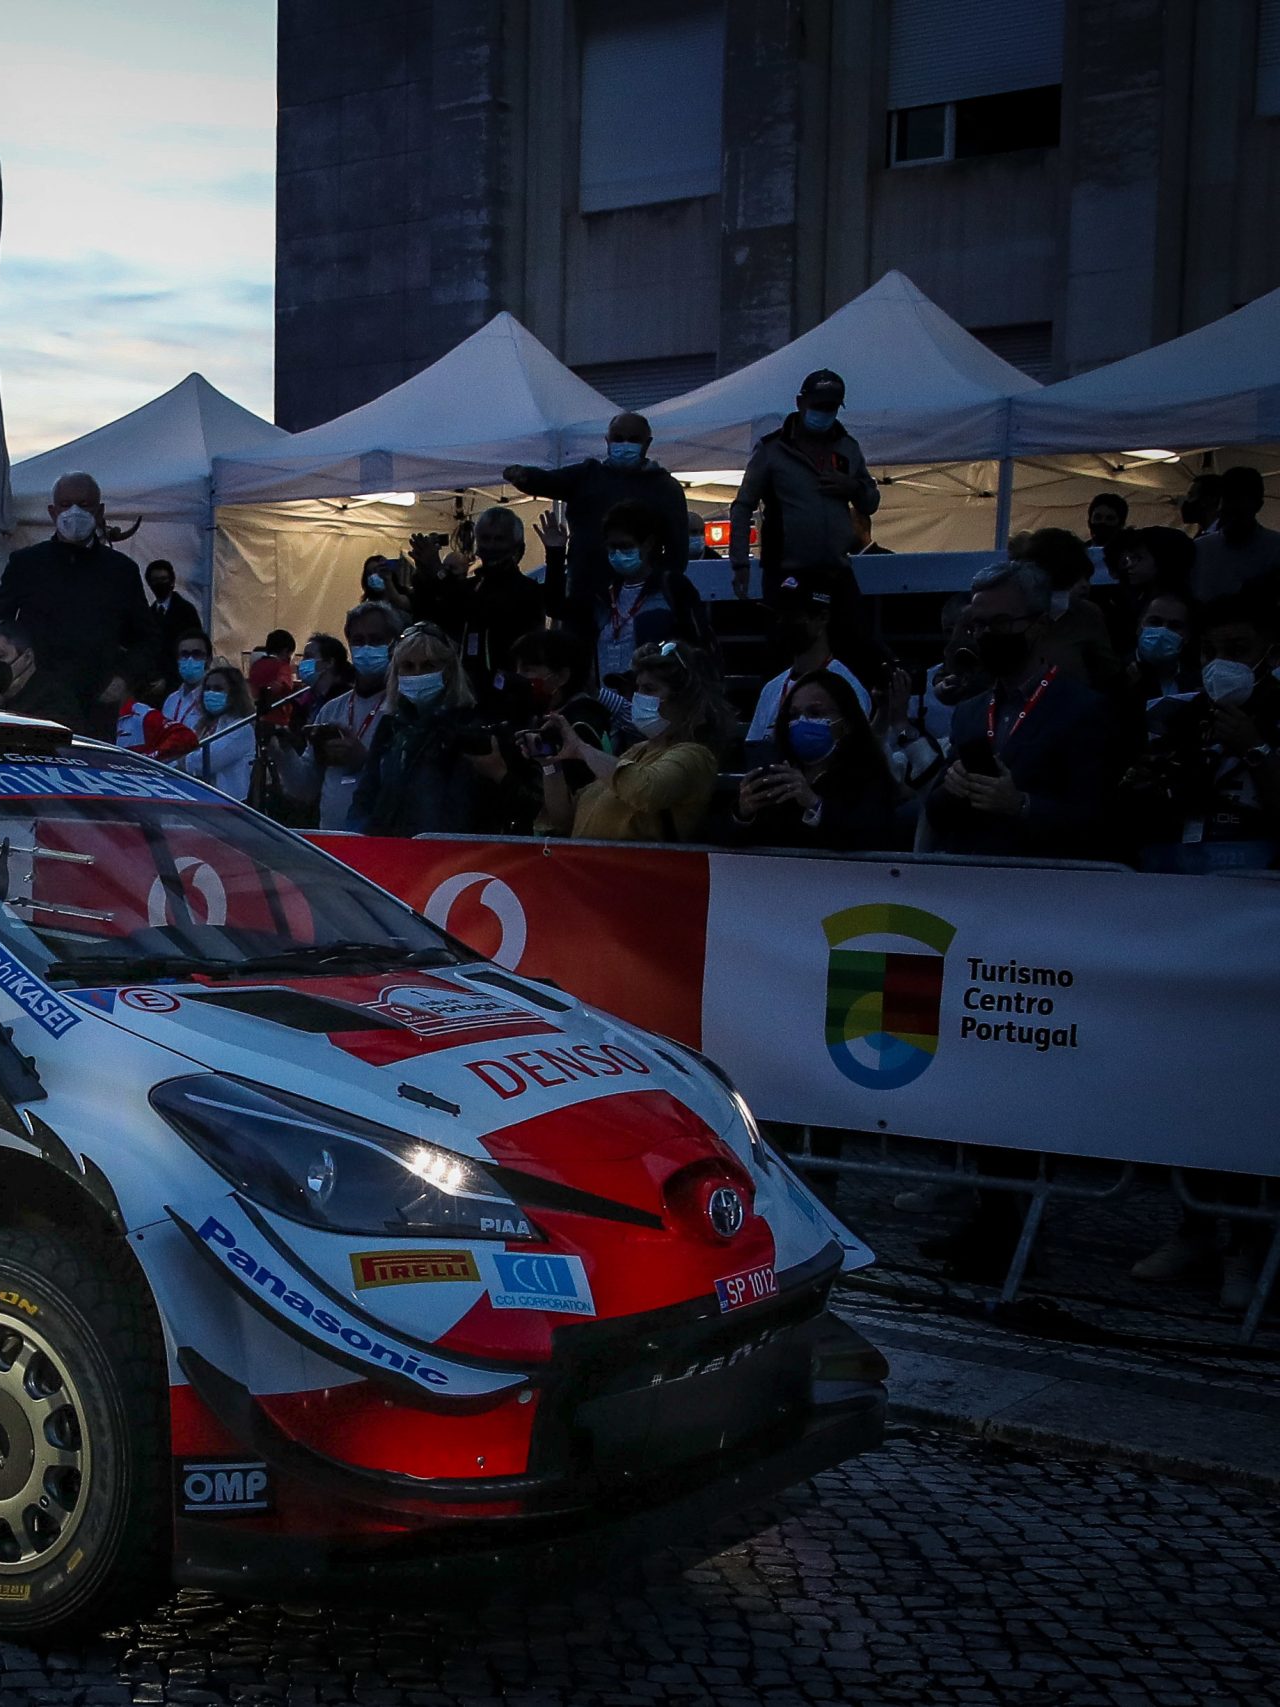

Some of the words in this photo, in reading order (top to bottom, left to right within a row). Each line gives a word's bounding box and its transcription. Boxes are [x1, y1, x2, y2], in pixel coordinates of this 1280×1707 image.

[4, 753, 90, 767] GAZOO
[967, 957, 1074, 988] Turismo
[963, 987, 1054, 1016] Centro
[960, 1016, 1078, 1053] Portugal
[462, 1043, 652, 1101] DENSO
[480, 1217, 530, 1235] PIAA
[360, 1253, 470, 1284] PIRELLI
[197, 1215, 449, 1387] Panasonic
[726, 1278, 746, 1305] SP
[749, 1268, 777, 1298] 1012
[495, 1295, 516, 1306] CCI
[520, 1295, 592, 1312] CORPORATION
[184, 1470, 267, 1502] OMP
